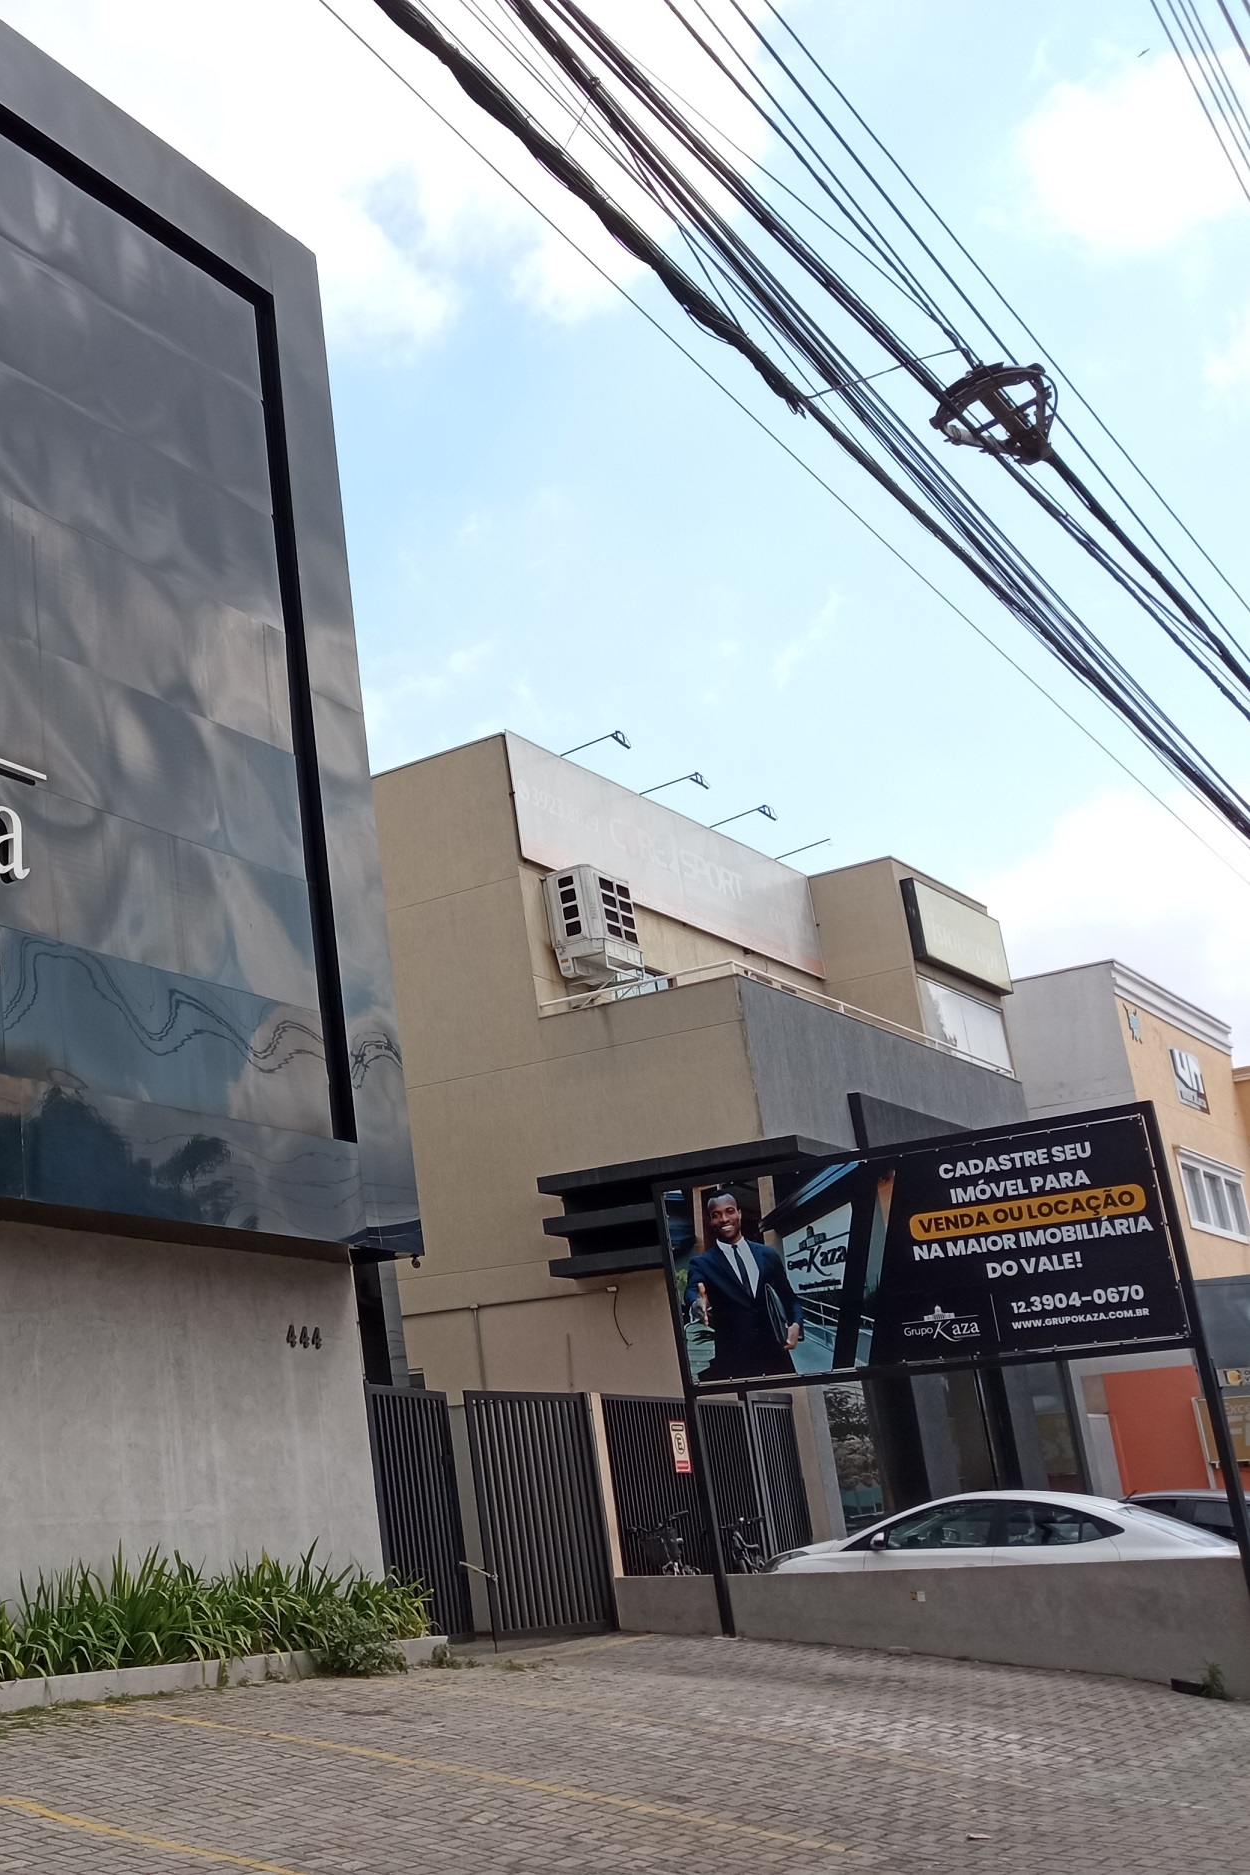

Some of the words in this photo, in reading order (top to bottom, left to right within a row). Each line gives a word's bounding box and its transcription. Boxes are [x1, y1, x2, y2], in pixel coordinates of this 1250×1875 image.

[679, 847, 743, 901] SPORT
[938, 1148, 1049, 1179] CADASTRE
[1051, 1141, 1092, 1162] SEU
[950, 1178, 1028, 1204] IMÓVEL
[1030, 1169, 1091, 1193] PARA
[918, 1211, 990, 1234] VENDA
[993, 1205, 1024, 1223] OU
[1027, 1189, 1135, 1220] LOCAÇÃO
[913, 1243, 945, 1261] NA
[946, 1234, 1017, 1257] MAIOR
[1018, 1215, 1154, 1248] IMOBILIÁRIA
[985, 1260, 1018, 1279] DO
[1020, 1251, 1083, 1274] VALE!
[1011, 1284, 1145, 1314] 12.3904-0670
[903, 1326, 934, 1337] Grupo
[932, 1319, 980, 1342] Kaza
[1011, 1307, 1150, 1330] WWW.GRUPOKAZA.COM.BR
[286, 1324, 322, 1350] 444
